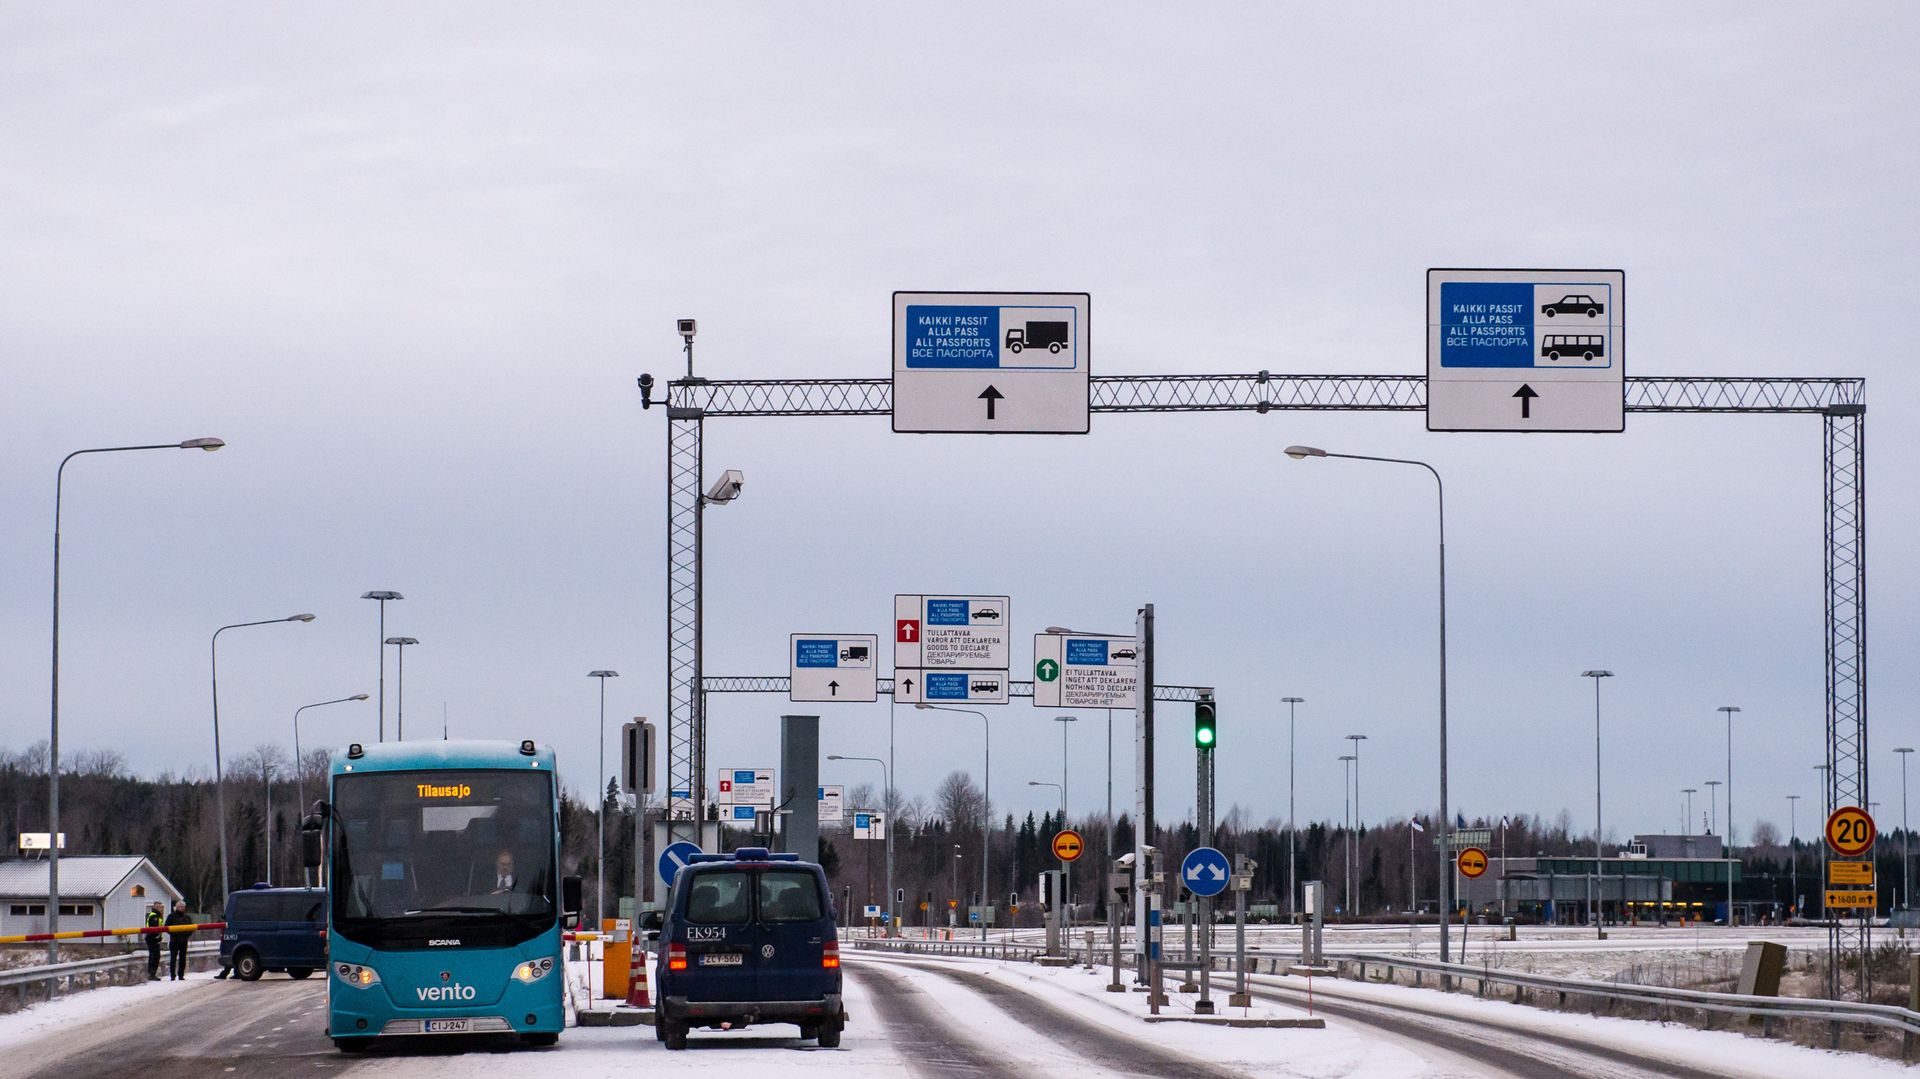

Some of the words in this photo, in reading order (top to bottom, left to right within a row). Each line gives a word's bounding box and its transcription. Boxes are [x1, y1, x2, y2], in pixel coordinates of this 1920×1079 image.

[1453, 304, 1486, 313] KAIKKI
[1490, 304, 1523, 313] PASSIT
[919, 316, 952, 325] KAIKKI
[955, 316, 988, 325] PASSIT
[1462, 315, 1486, 324] ALLA
[1489, 315, 1513, 324] PASS
[928, 327, 951, 336] ALLA
[954, 327, 979, 336] PASS
[1450, 327, 1468, 336] ALL
[1470, 327, 1525, 336] PASSPORTS
[915, 338, 934, 347] ALL
[936, 338, 991, 347] PASSPORTS
[1446, 337, 1468, 347] ВСЕ
[1470, 337, 1529, 347] ПАСПОРТА
[912, 348, 933, 358] ВСЕ
[936, 348, 994, 358] ПАСПОРТА
[417, 784, 471, 798] Tilausajo
[1837, 818, 1868, 844] 20
[1838, 895, 1857, 904] 1600
[687, 926, 727, 939] EK954
[706, 954, 740, 964] ZCY-560
[416, 982, 476, 1001] vento
[432, 1021, 466, 1030] CIJ-247
